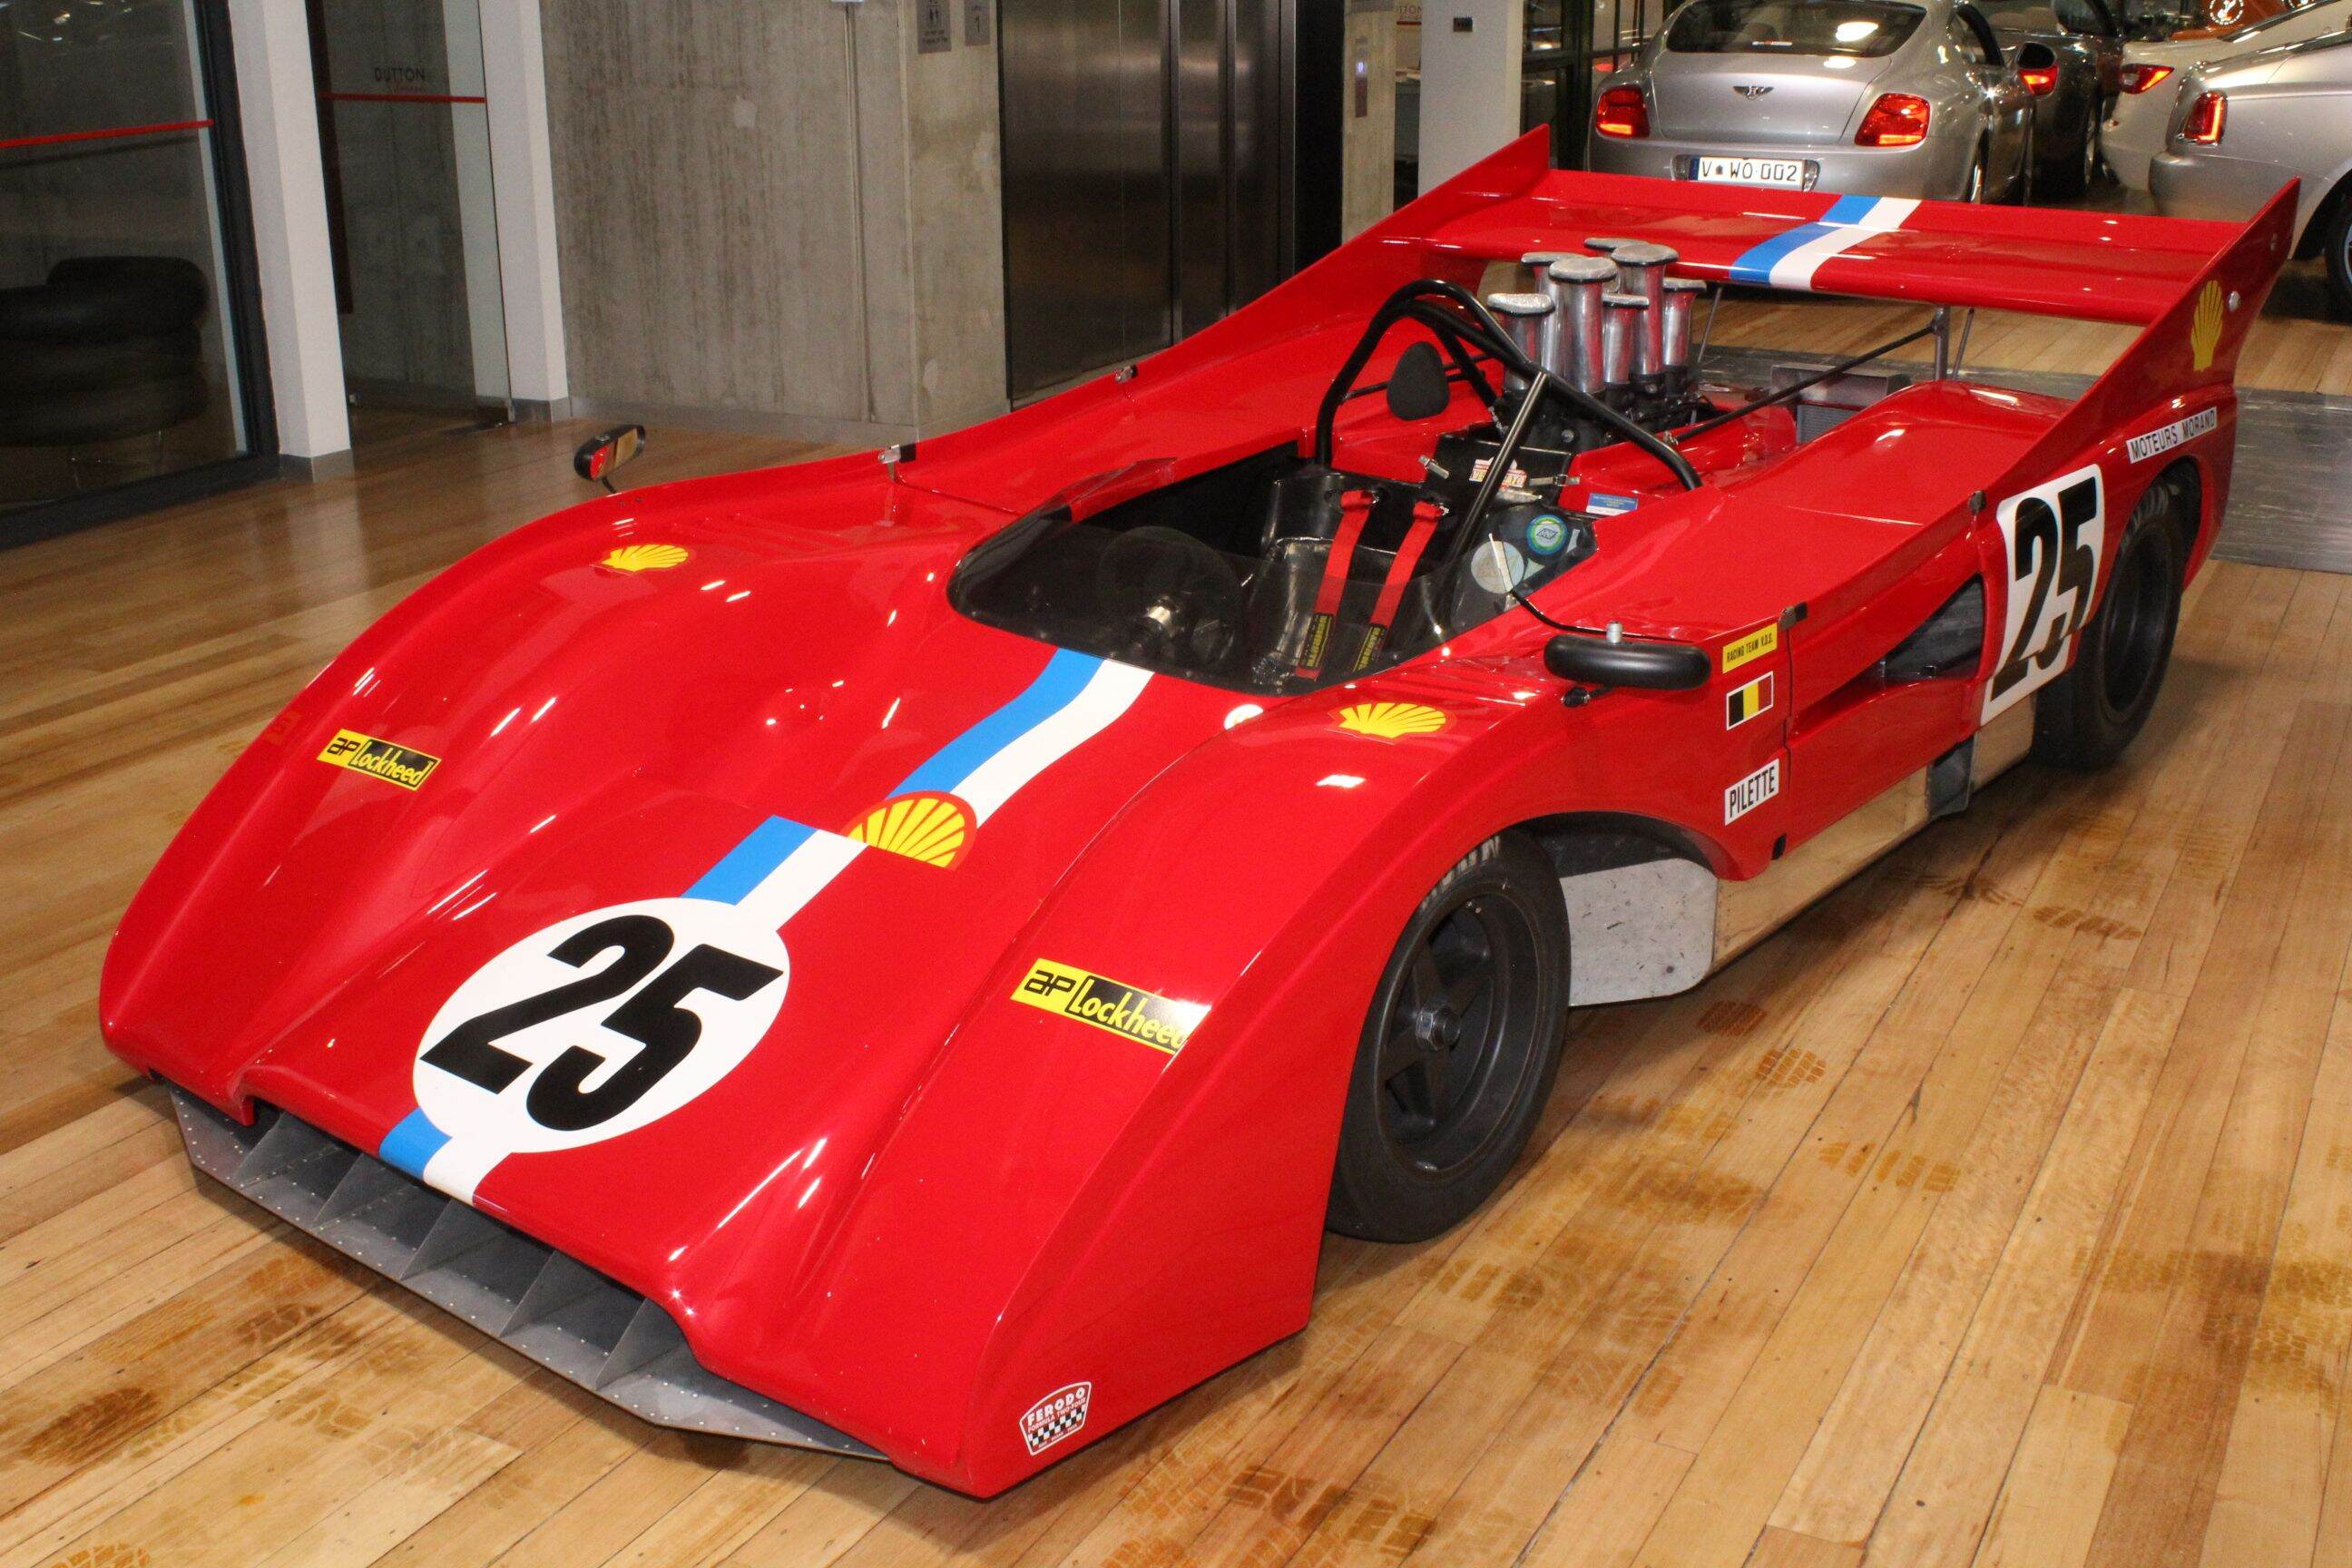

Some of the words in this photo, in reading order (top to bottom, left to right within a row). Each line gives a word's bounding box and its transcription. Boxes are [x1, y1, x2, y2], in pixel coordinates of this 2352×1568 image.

[373, 67, 426, 83] DUTTON
[1702, 160, 1712, 178] V
[2130, 425, 2179, 460] MOTEURS
[2181, 409, 2215, 439] MORAND
[1989, 475, 2097, 702] 25
[1727, 645, 1745, 662] RACING
[1745, 639, 1759, 654] TEAM
[350, 740, 435, 786] Lockheed
[1730, 765, 1775, 818] PILETTE
[419, 914, 784, 1132] 25
[1027, 1387, 1086, 1426] FERODO
